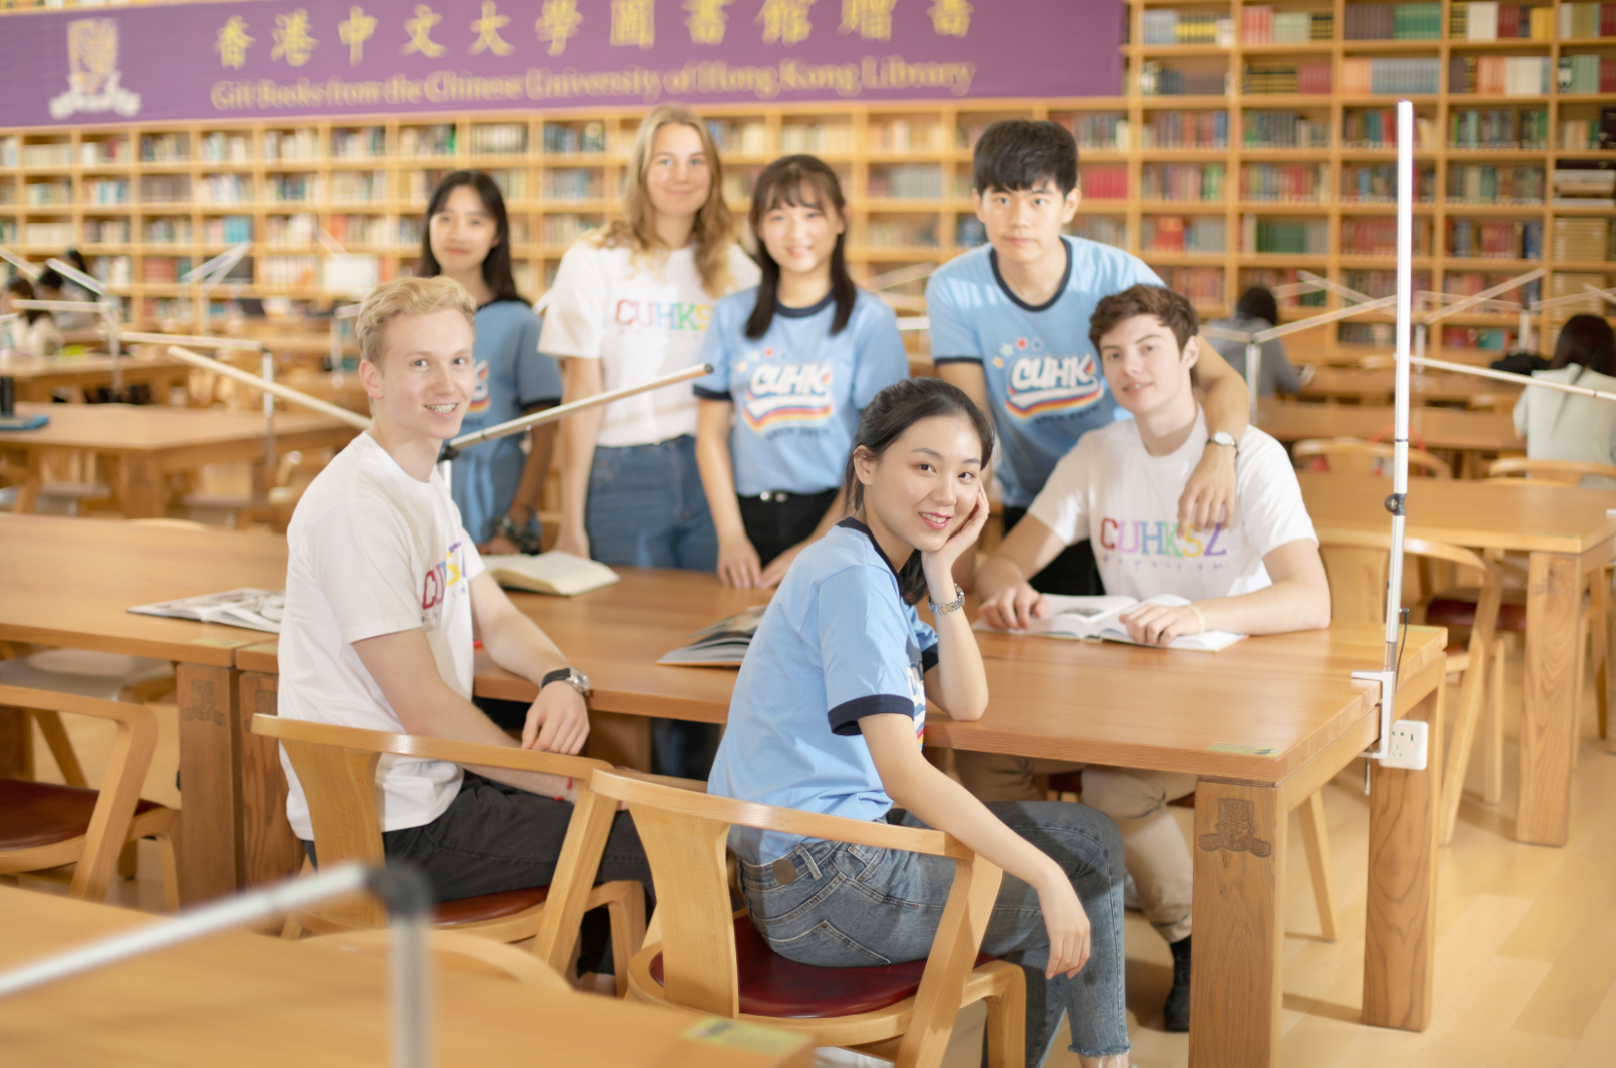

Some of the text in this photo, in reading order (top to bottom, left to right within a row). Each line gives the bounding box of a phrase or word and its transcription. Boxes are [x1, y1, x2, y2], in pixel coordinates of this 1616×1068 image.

[257, 78, 327, 108] Books
[327, 75, 384, 106] from
[385, 73, 424, 104] the
[425, 70, 525, 102] Chinese
[526, 65, 662, 103] University
[664, 60, 699, 94] of
[698, 60, 779, 100] Hong
[779, 57, 862, 98] Kong
[862, 55, 975, 95] Library
[750, 363, 832, 397] CUHK
[1010, 354, 1094, 391] CUHK
[1100, 517, 1227, 558] CUHKSZ
